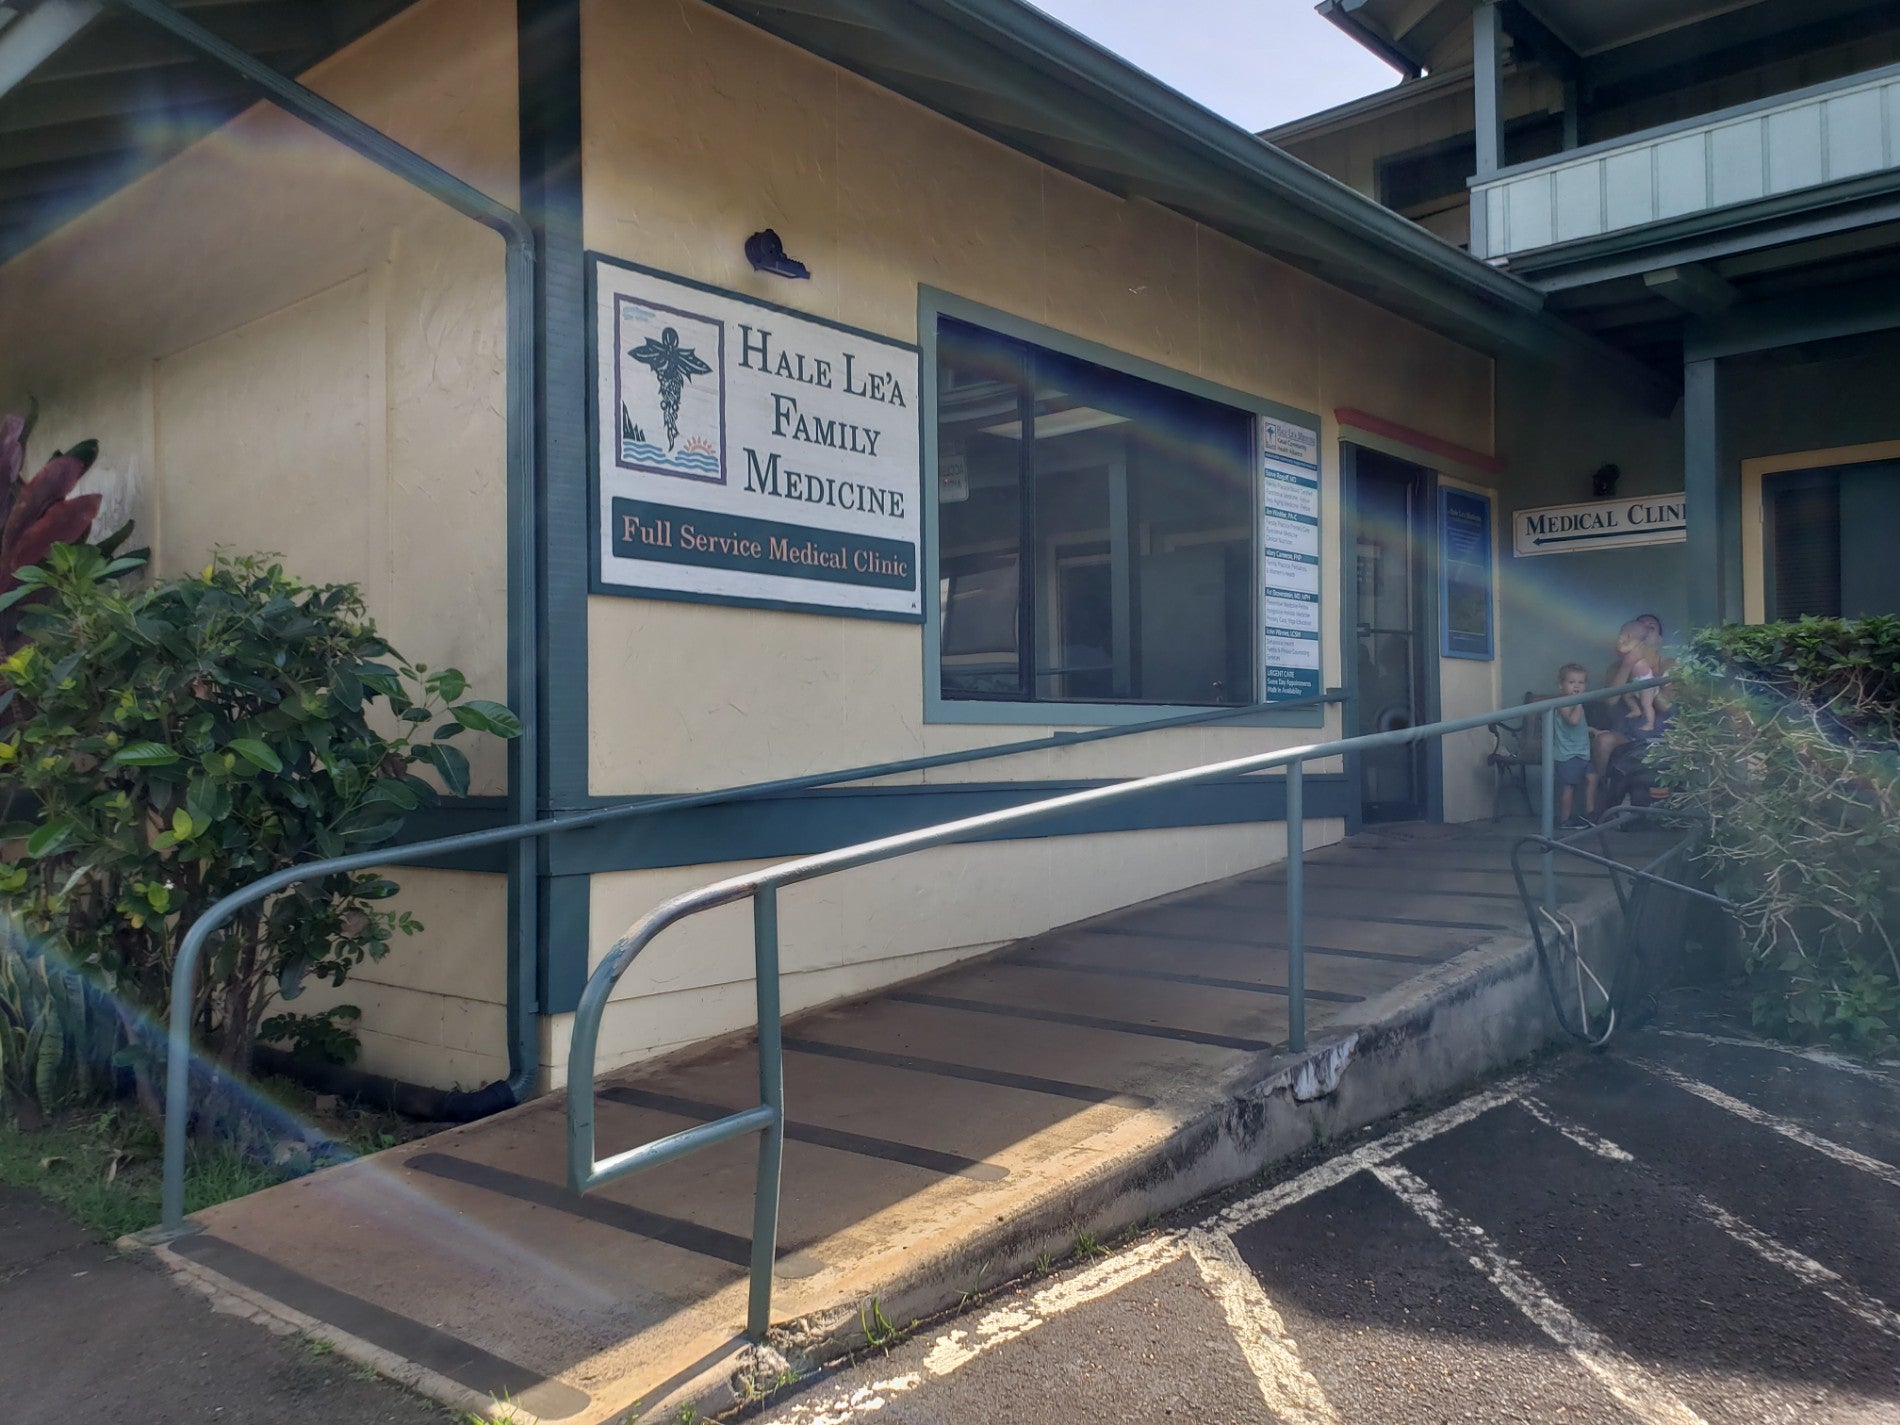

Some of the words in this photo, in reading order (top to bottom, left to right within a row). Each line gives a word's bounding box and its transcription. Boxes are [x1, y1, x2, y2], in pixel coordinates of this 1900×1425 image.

[737, 323, 832, 390] HALE
[842, 352, 907, 408] LE'A
[770, 392, 881, 457] FAMILY
[742, 447, 905, 519] MEDICINE
[621, 514, 673, 547] Full
[679, 525, 762, 558] Service
[768, 536, 848, 570] Medical
[853, 548, 908, 578] Clinic
[1525, 511, 1618, 536] MEDICAL
[1627, 503, 1686, 525] CLINI
